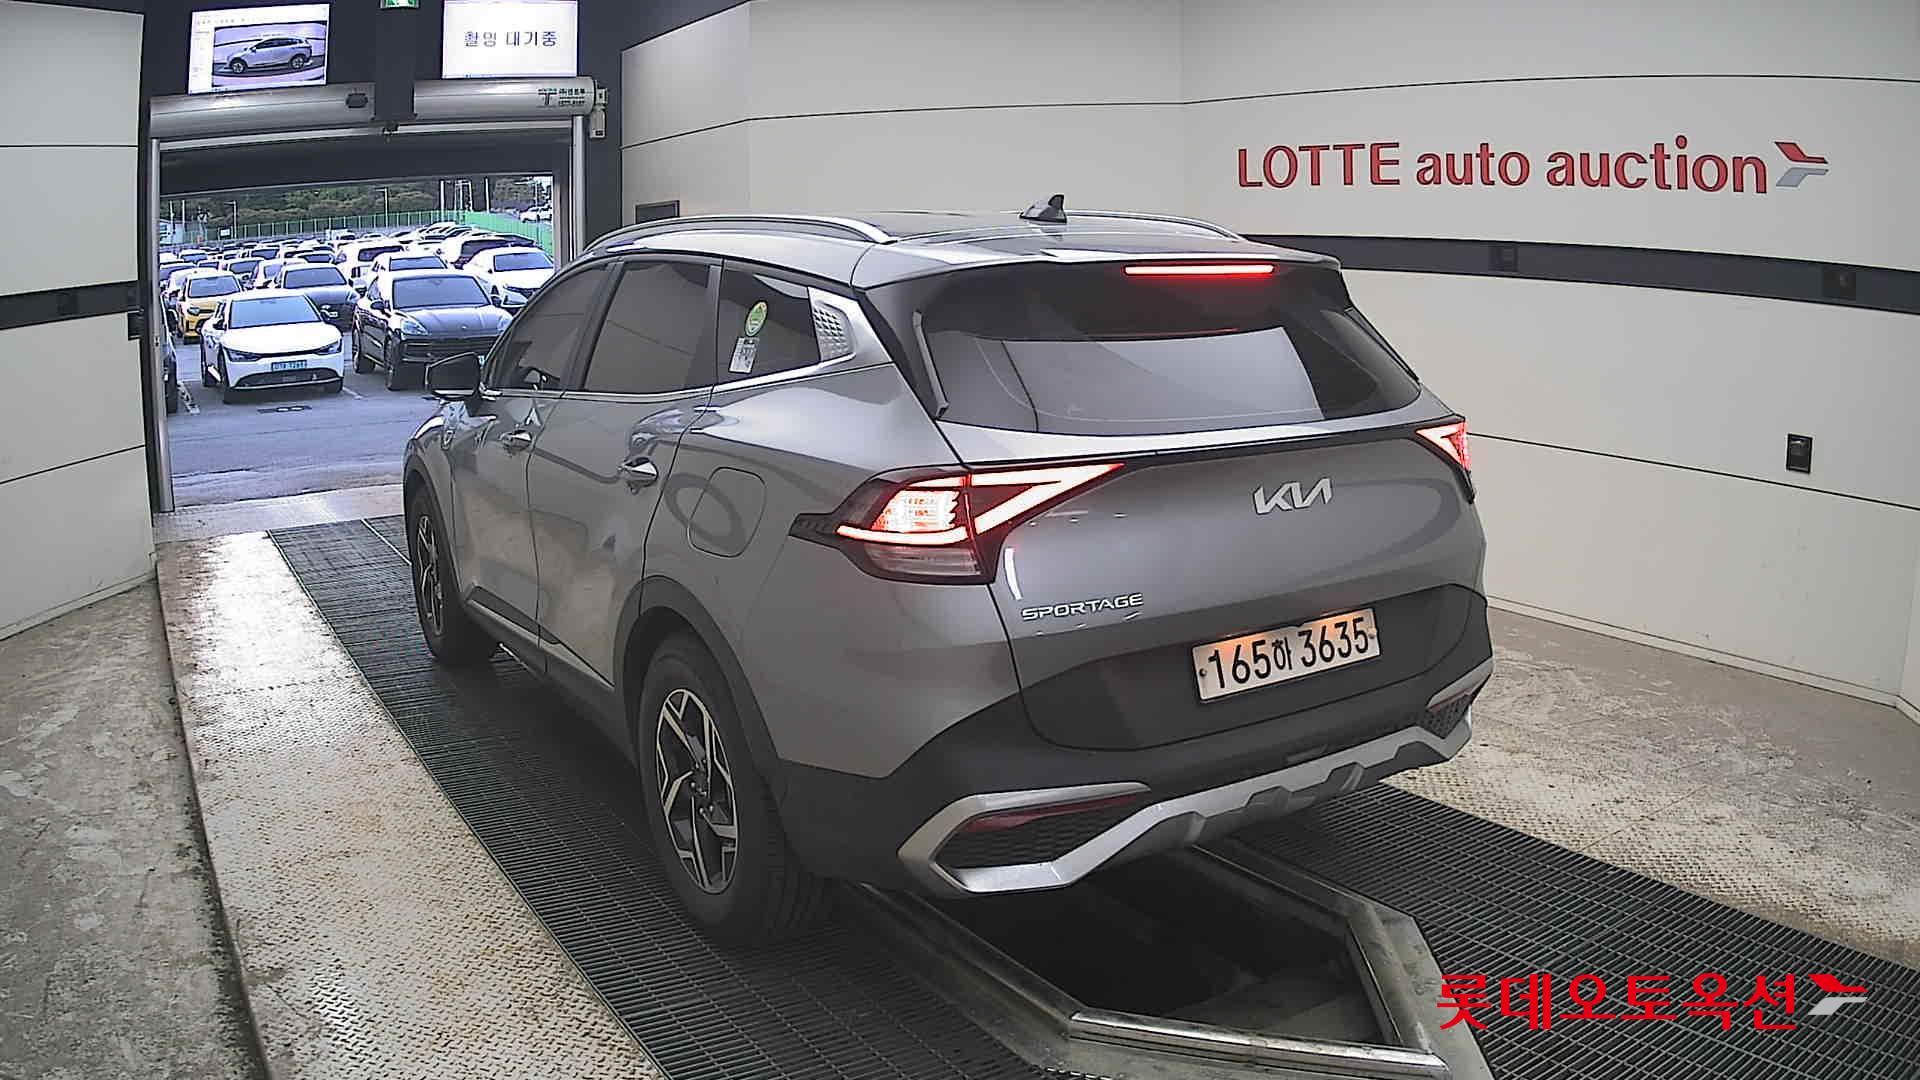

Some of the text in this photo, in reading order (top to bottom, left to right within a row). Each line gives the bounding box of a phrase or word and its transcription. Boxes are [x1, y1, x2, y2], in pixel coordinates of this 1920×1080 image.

[506, 31, 558, 47] 대기중
[1237, 135, 1768, 194] LOTTE auto auction
[1021, 592, 1144, 621] SPORTAGE
[1298, 617, 1369, 668] 3635
